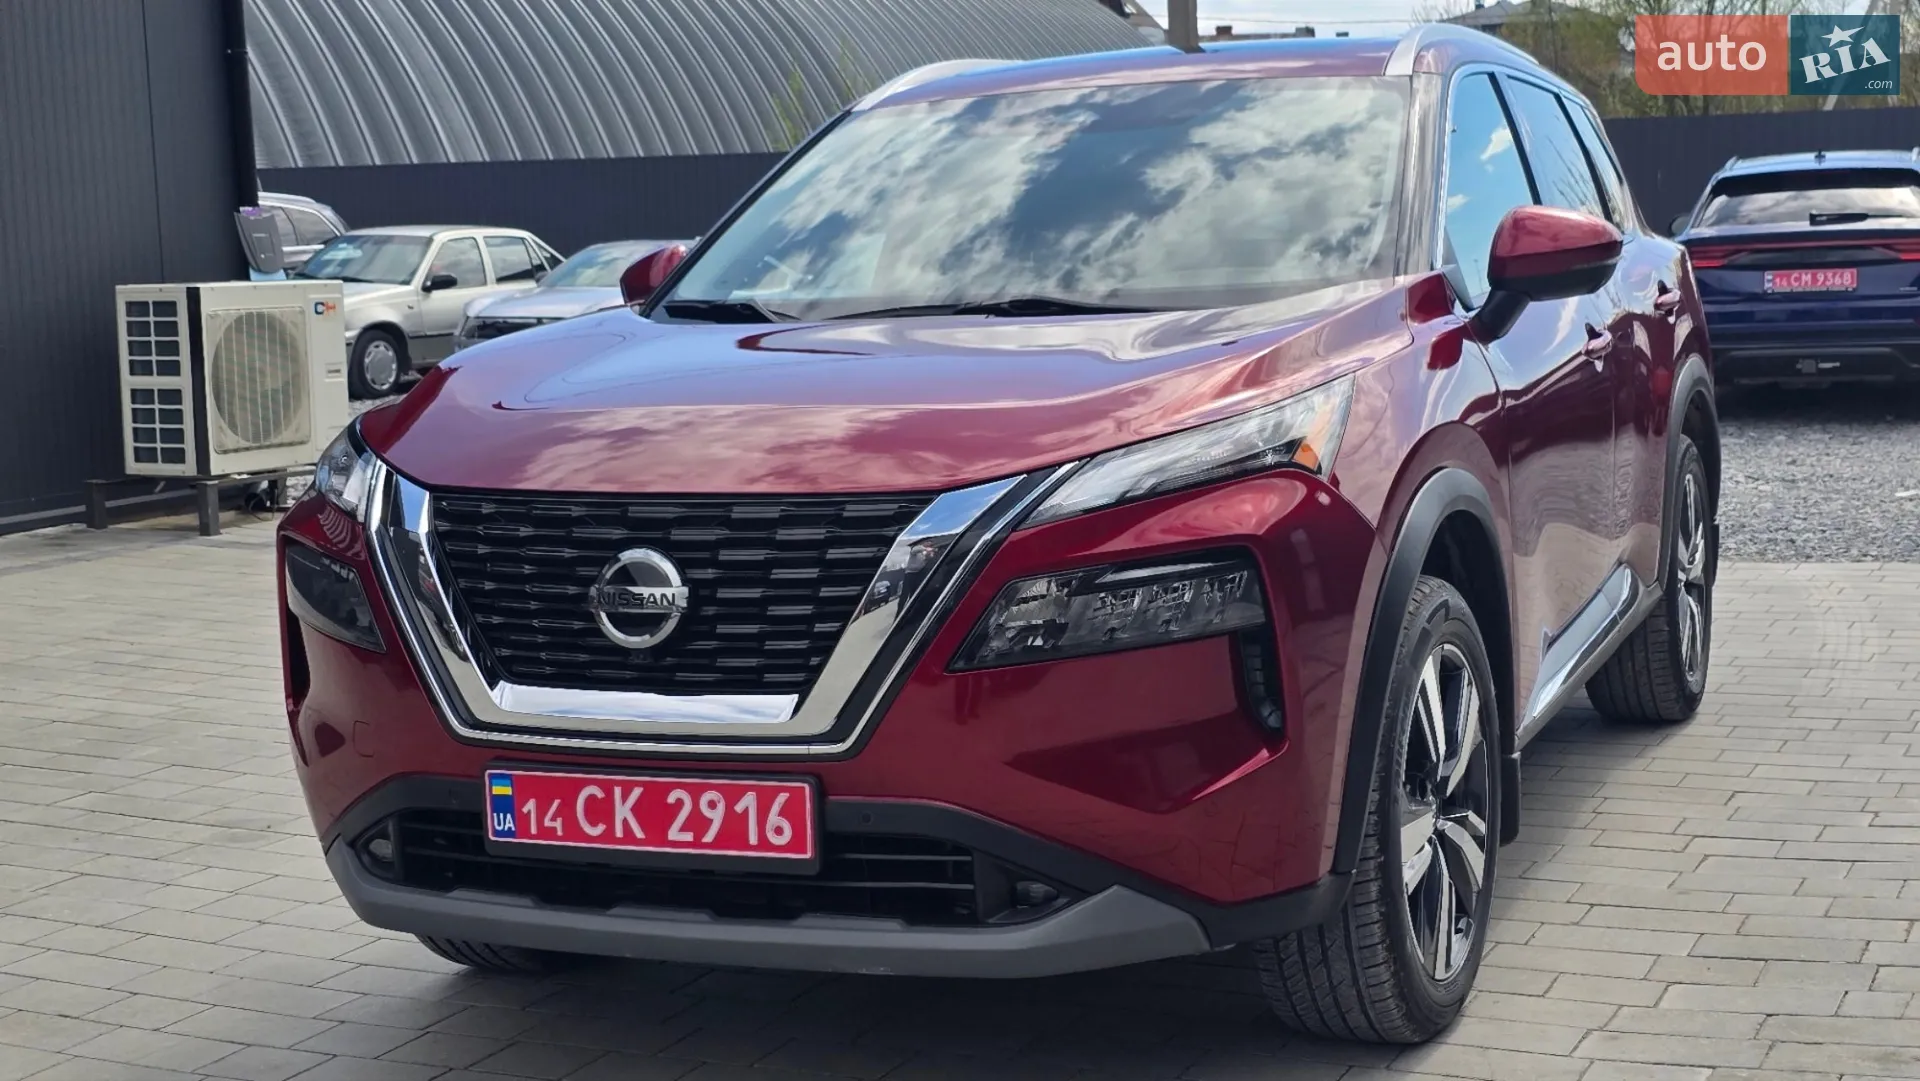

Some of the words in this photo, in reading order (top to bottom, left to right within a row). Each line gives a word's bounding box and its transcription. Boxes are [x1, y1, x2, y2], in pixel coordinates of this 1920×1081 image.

[599, 592, 676, 607] NISSAN
[493, 812, 516, 832] UA
[521, 798, 563, 836] 14
[576, 785, 646, 840] CK
[666, 788, 793, 846] 2916
